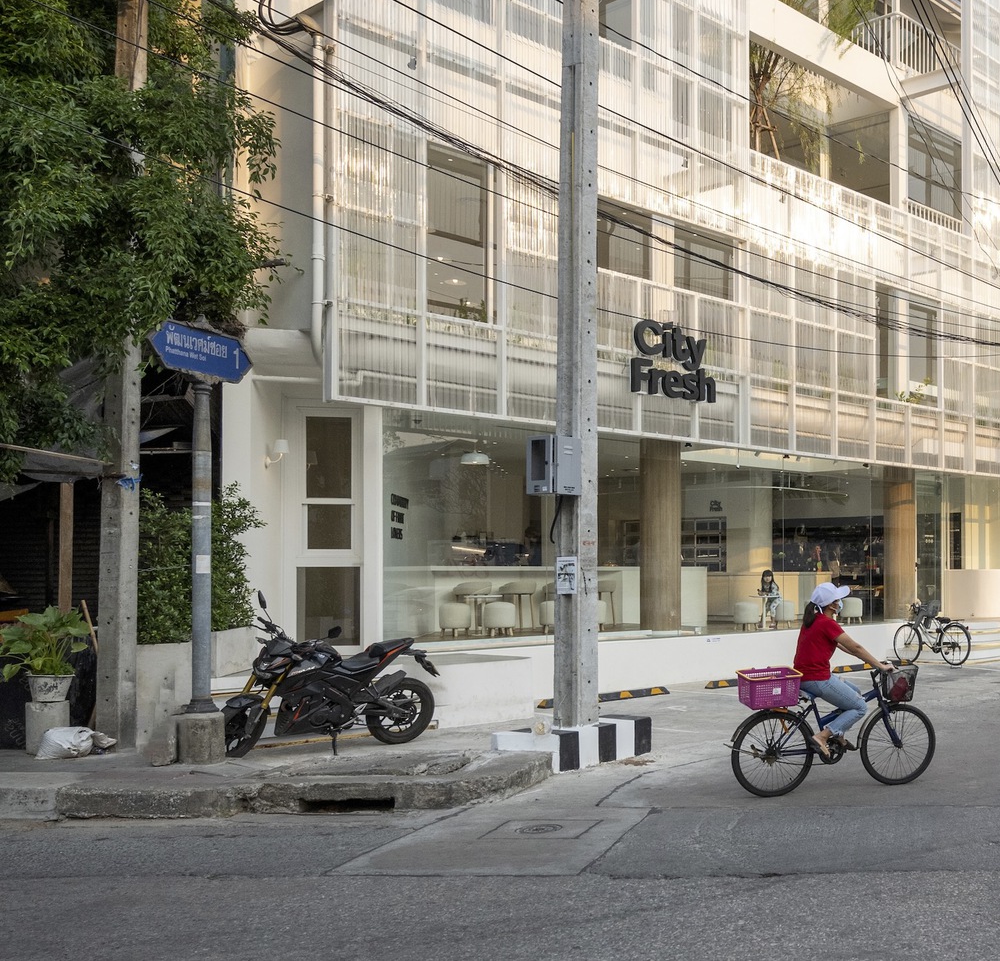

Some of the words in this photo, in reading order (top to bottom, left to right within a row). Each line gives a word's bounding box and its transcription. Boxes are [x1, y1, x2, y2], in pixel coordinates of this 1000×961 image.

[233, 347, 239, 369] 1
[634, 319, 707, 371] City
[631, 357, 716, 403] Fresh
